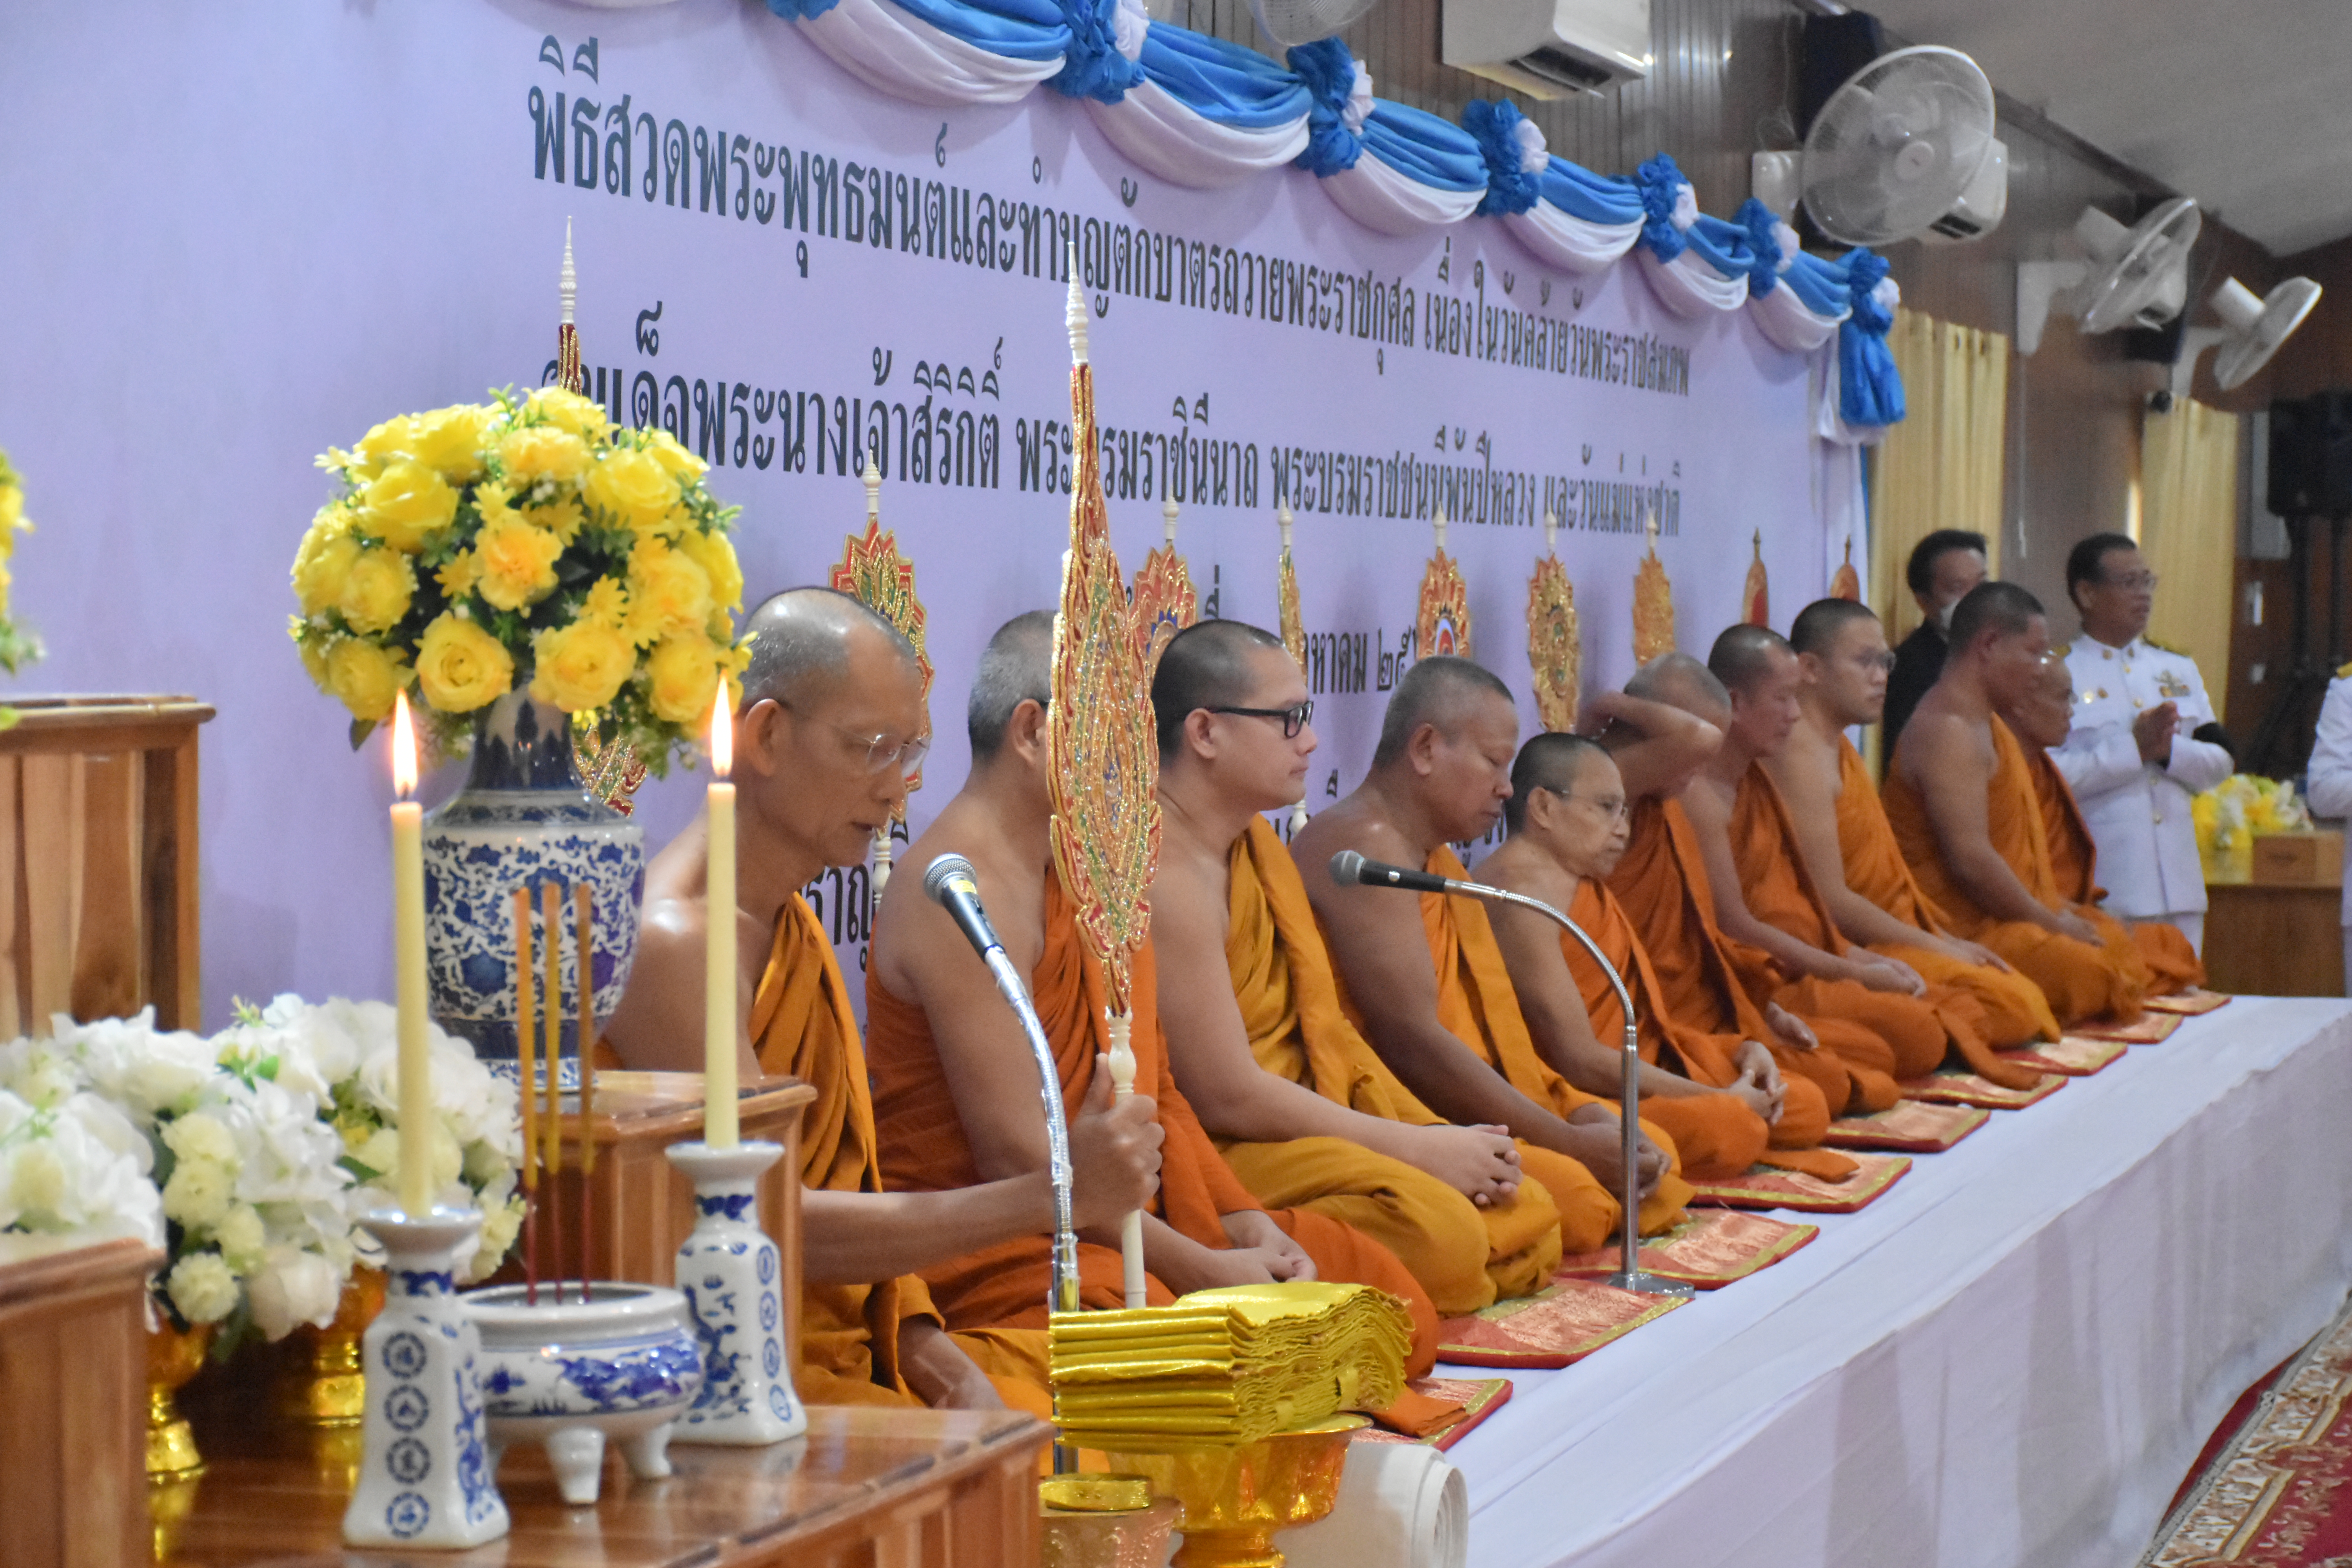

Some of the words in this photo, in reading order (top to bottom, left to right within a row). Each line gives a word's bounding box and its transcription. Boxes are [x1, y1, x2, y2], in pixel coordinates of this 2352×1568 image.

[528, 34, 1414, 375] พิธีสวดพระพุทธมนต์และทำบญตักบาตรถวายพระราชกุศล
[541, 301, 1003, 489] เด็จพระนางเจ้าสิริกิติ์
[1016, 392, 1258, 508] พระรมราชินีนาถ
